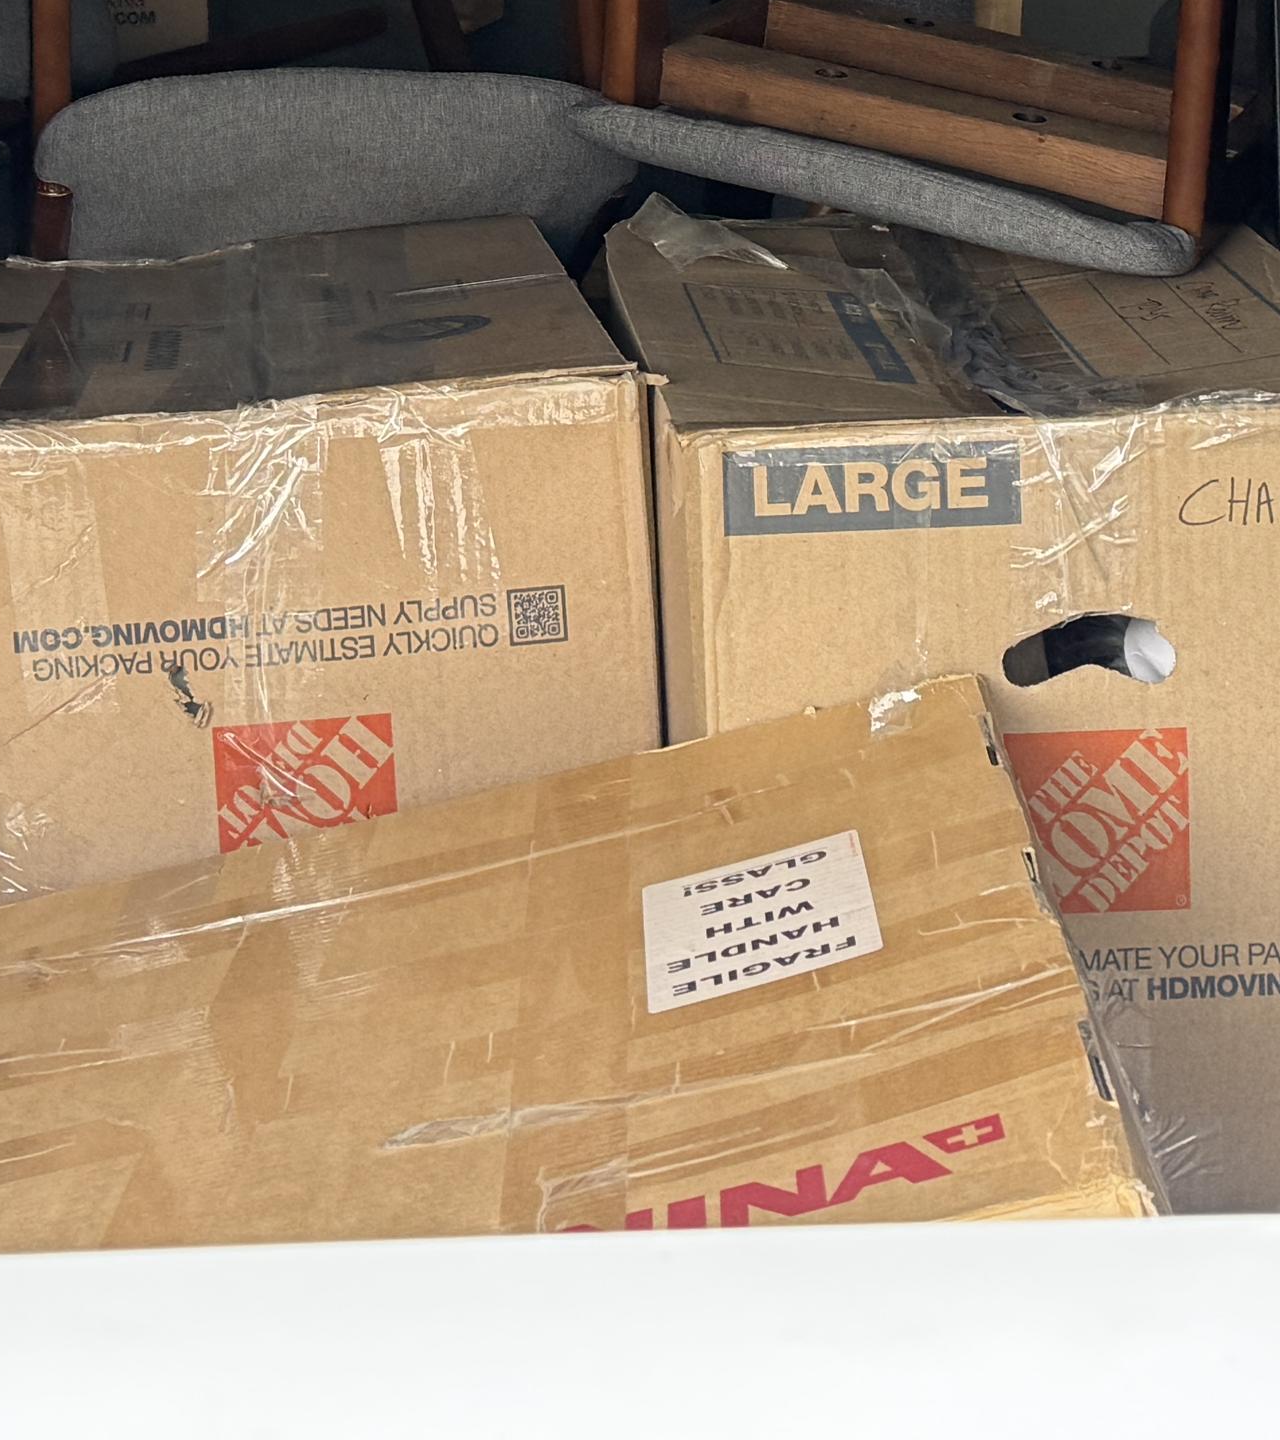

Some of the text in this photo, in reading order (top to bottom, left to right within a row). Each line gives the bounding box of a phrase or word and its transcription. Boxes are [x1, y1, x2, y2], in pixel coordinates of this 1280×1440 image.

[753, 456, 990, 517] LARGE
[13, 592, 497, 654] SUPPLY NEEDS AT HDMOVING.COM
[32, 623, 500, 682] QUICKLY ESTIMATE YOUR PACKING
[1028, 749, 1099, 826] THE
[683, 850, 827, 898] GLASS!
[1078, 795, 1191, 913] DEPOT
[700, 878, 811, 916] CARE
[706, 900, 814, 939] WITH
[667, 916, 840, 974] HANDLE
[672, 936, 857, 997] FRAGILE
[1158, 942, 1240, 969] YOUR
[1108, 978, 1140, 1003] AT
